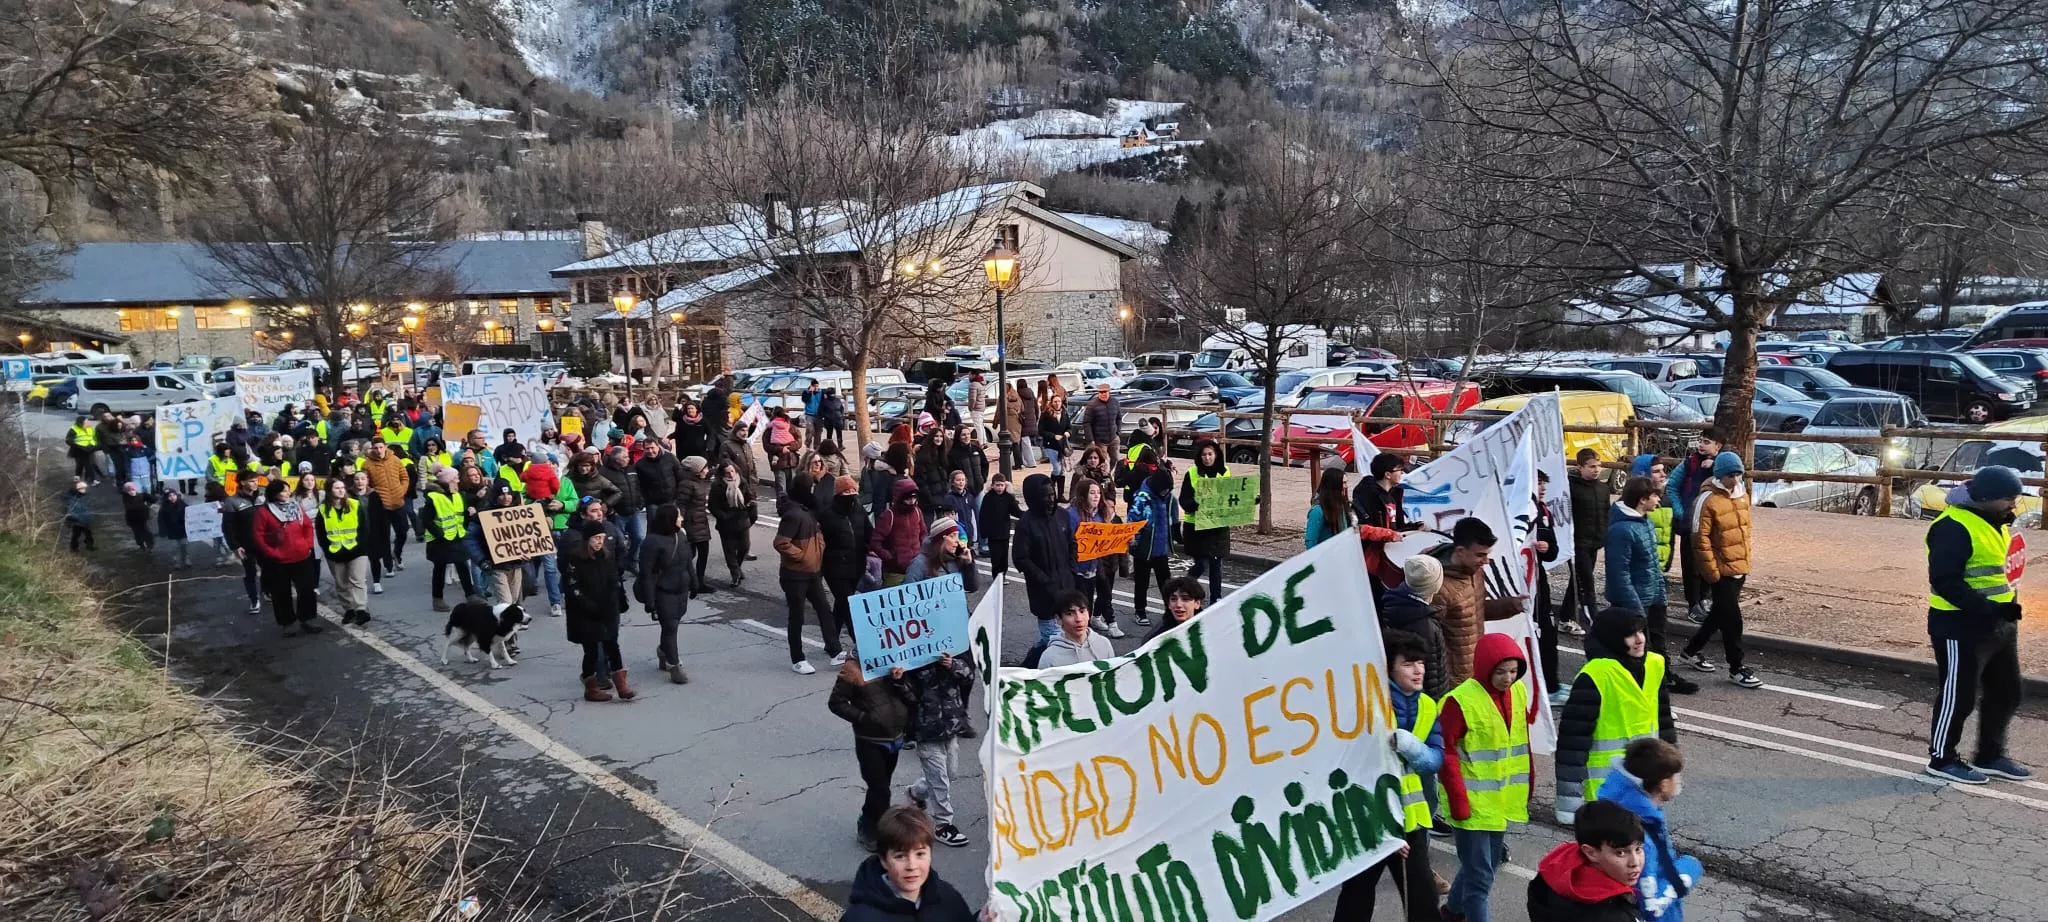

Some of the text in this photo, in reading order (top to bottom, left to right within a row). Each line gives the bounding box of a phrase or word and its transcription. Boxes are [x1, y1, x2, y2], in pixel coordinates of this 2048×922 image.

[392, 346, 405, 361] P
[8, 361, 25, 378] P
[443, 375, 499, 399] VALLE
[491, 507, 535, 523] TODOS
[492, 521, 542, 542] UNIDOS
[494, 535, 554, 558] CRECEMOS
[2006, 548, 2025, 573] STOP
[1239, 563, 1336, 658] DE
[878, 619, 931, 650] ¡NO!
[1148, 712, 1228, 793] NO
[1243, 676, 1320, 765] ES
